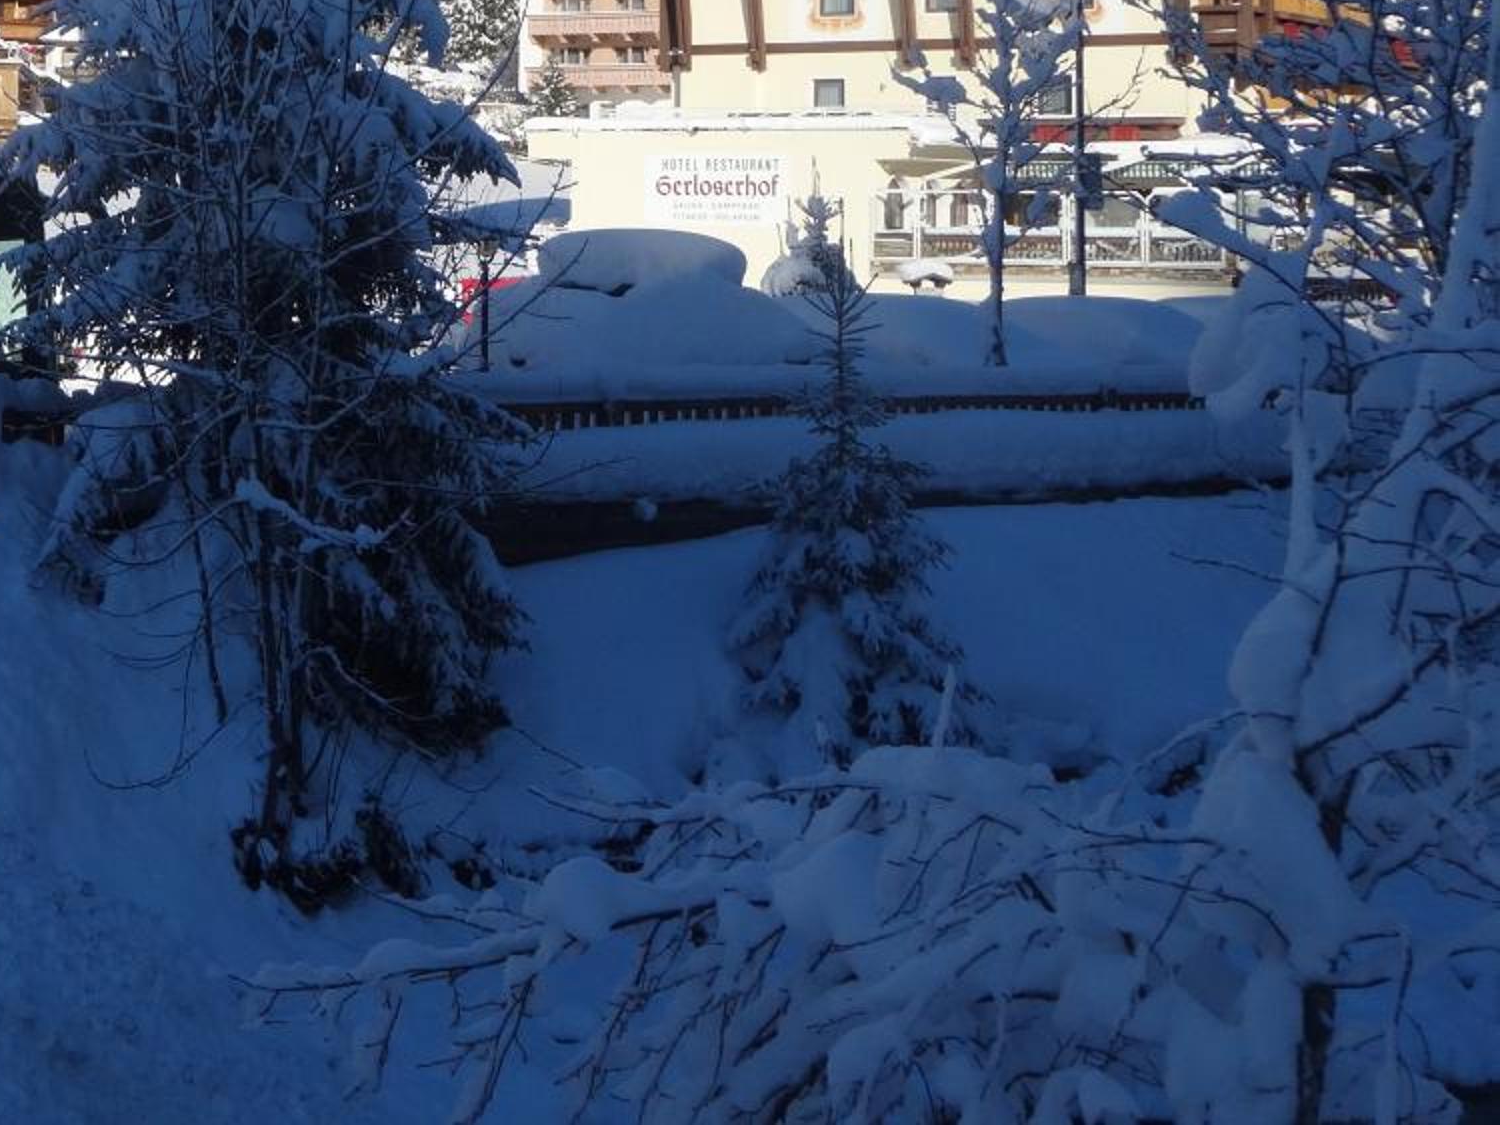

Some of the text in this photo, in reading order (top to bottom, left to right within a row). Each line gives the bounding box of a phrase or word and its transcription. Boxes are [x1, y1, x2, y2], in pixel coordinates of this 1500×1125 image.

[661, 158, 780, 172] HOTEL RESTAURANT
[655, 173, 780, 198] Gerloserhof
